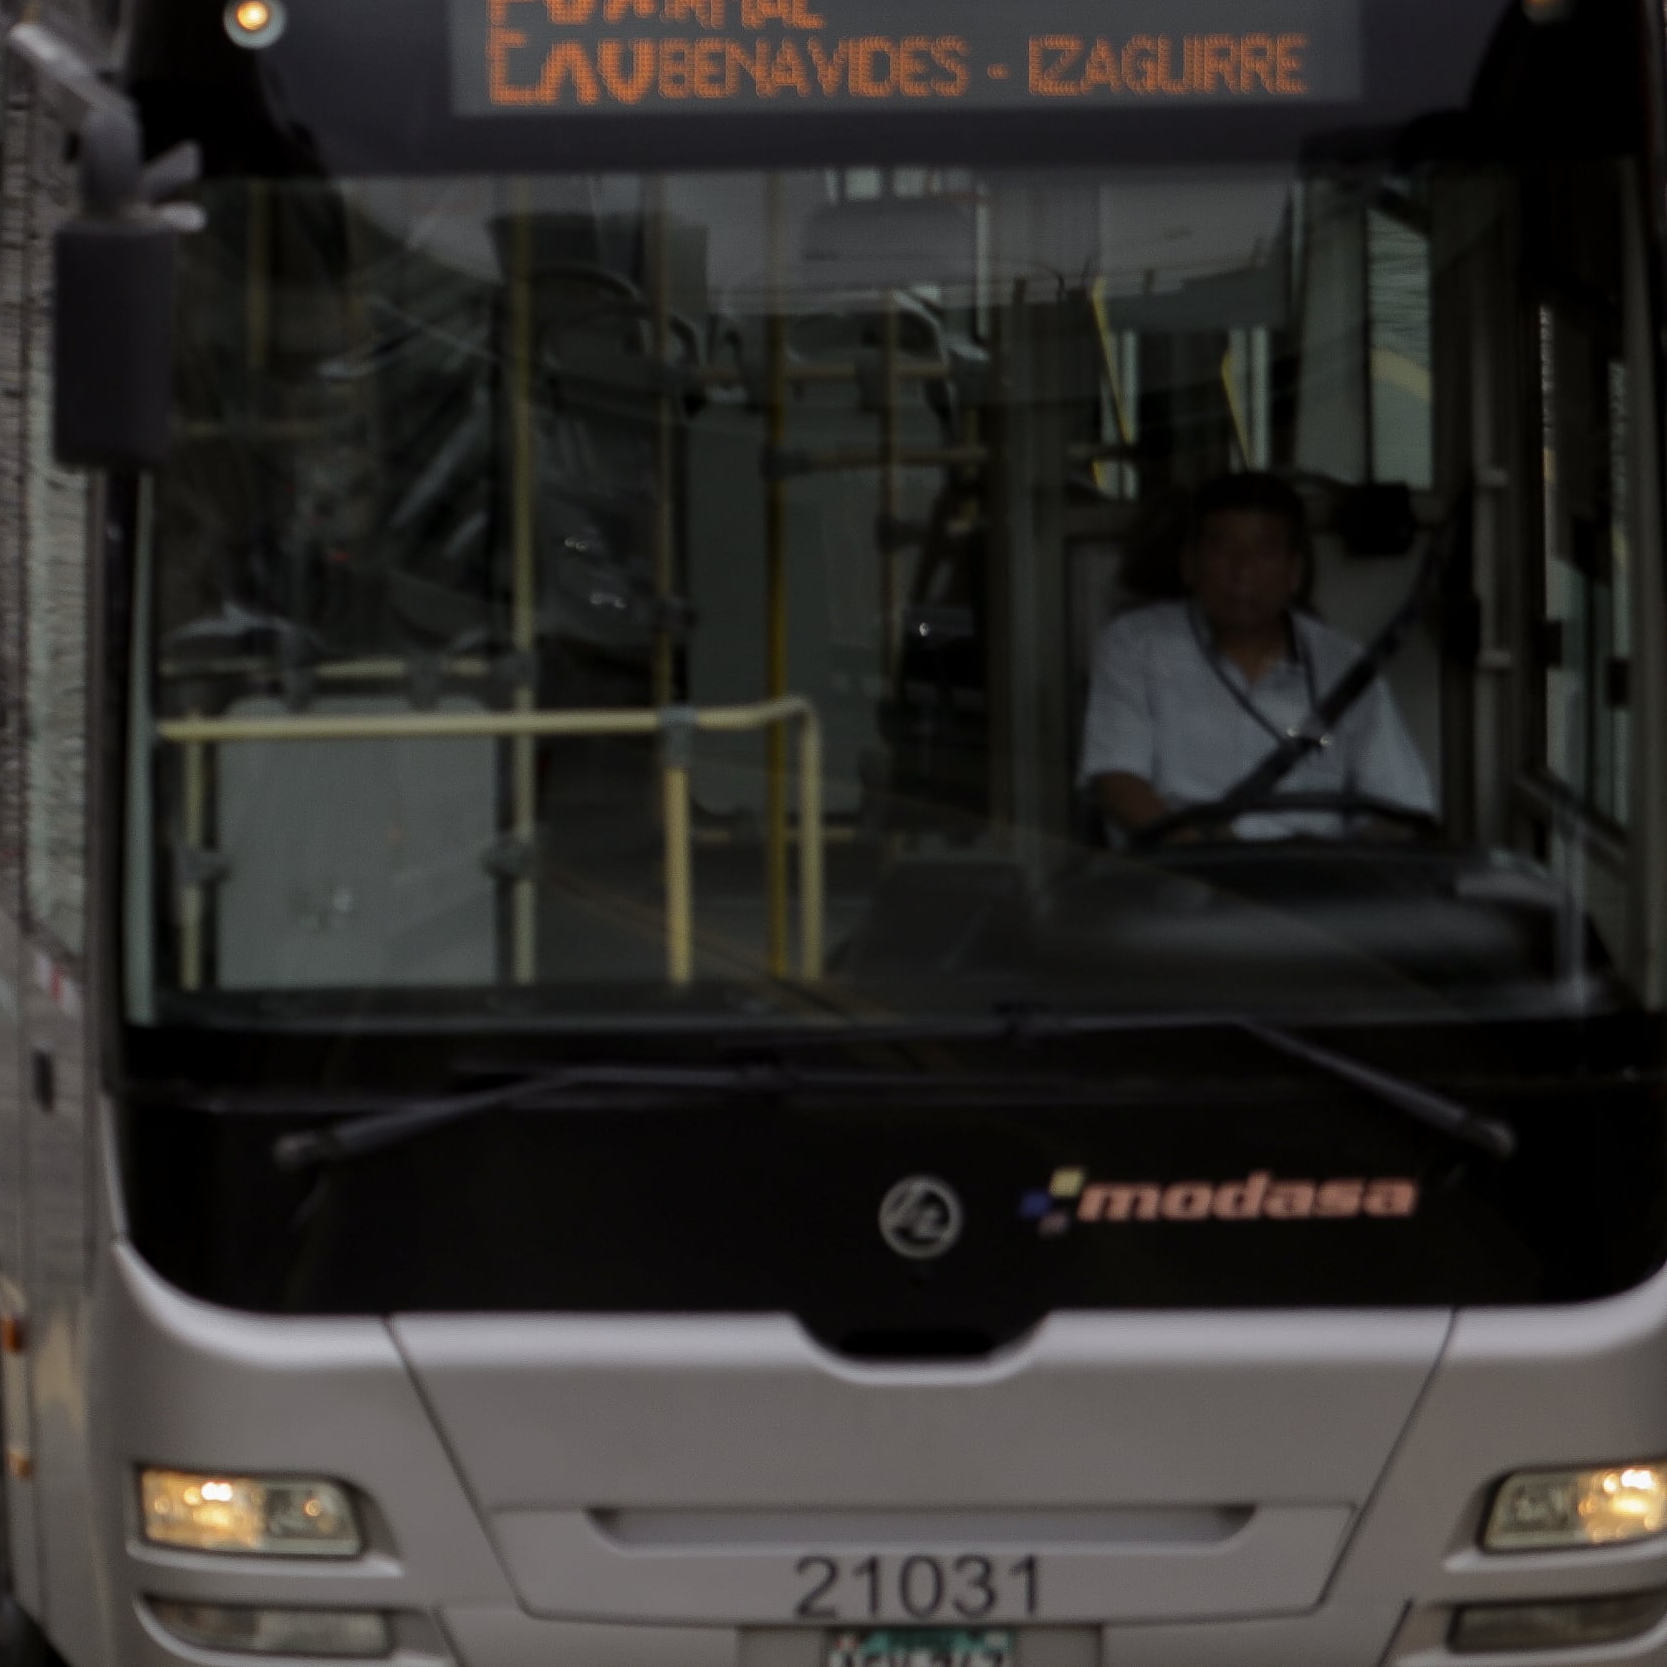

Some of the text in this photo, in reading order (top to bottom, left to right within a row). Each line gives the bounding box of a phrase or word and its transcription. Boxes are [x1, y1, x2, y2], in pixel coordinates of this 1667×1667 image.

[660, 35, 968, 99] BENAVIDES
[1027, 33, 1309, 97] IZAGUIRRE
[1076, 1170, 1417, 1222] modasa
[793, 1554, 1039, 1618] 21031
